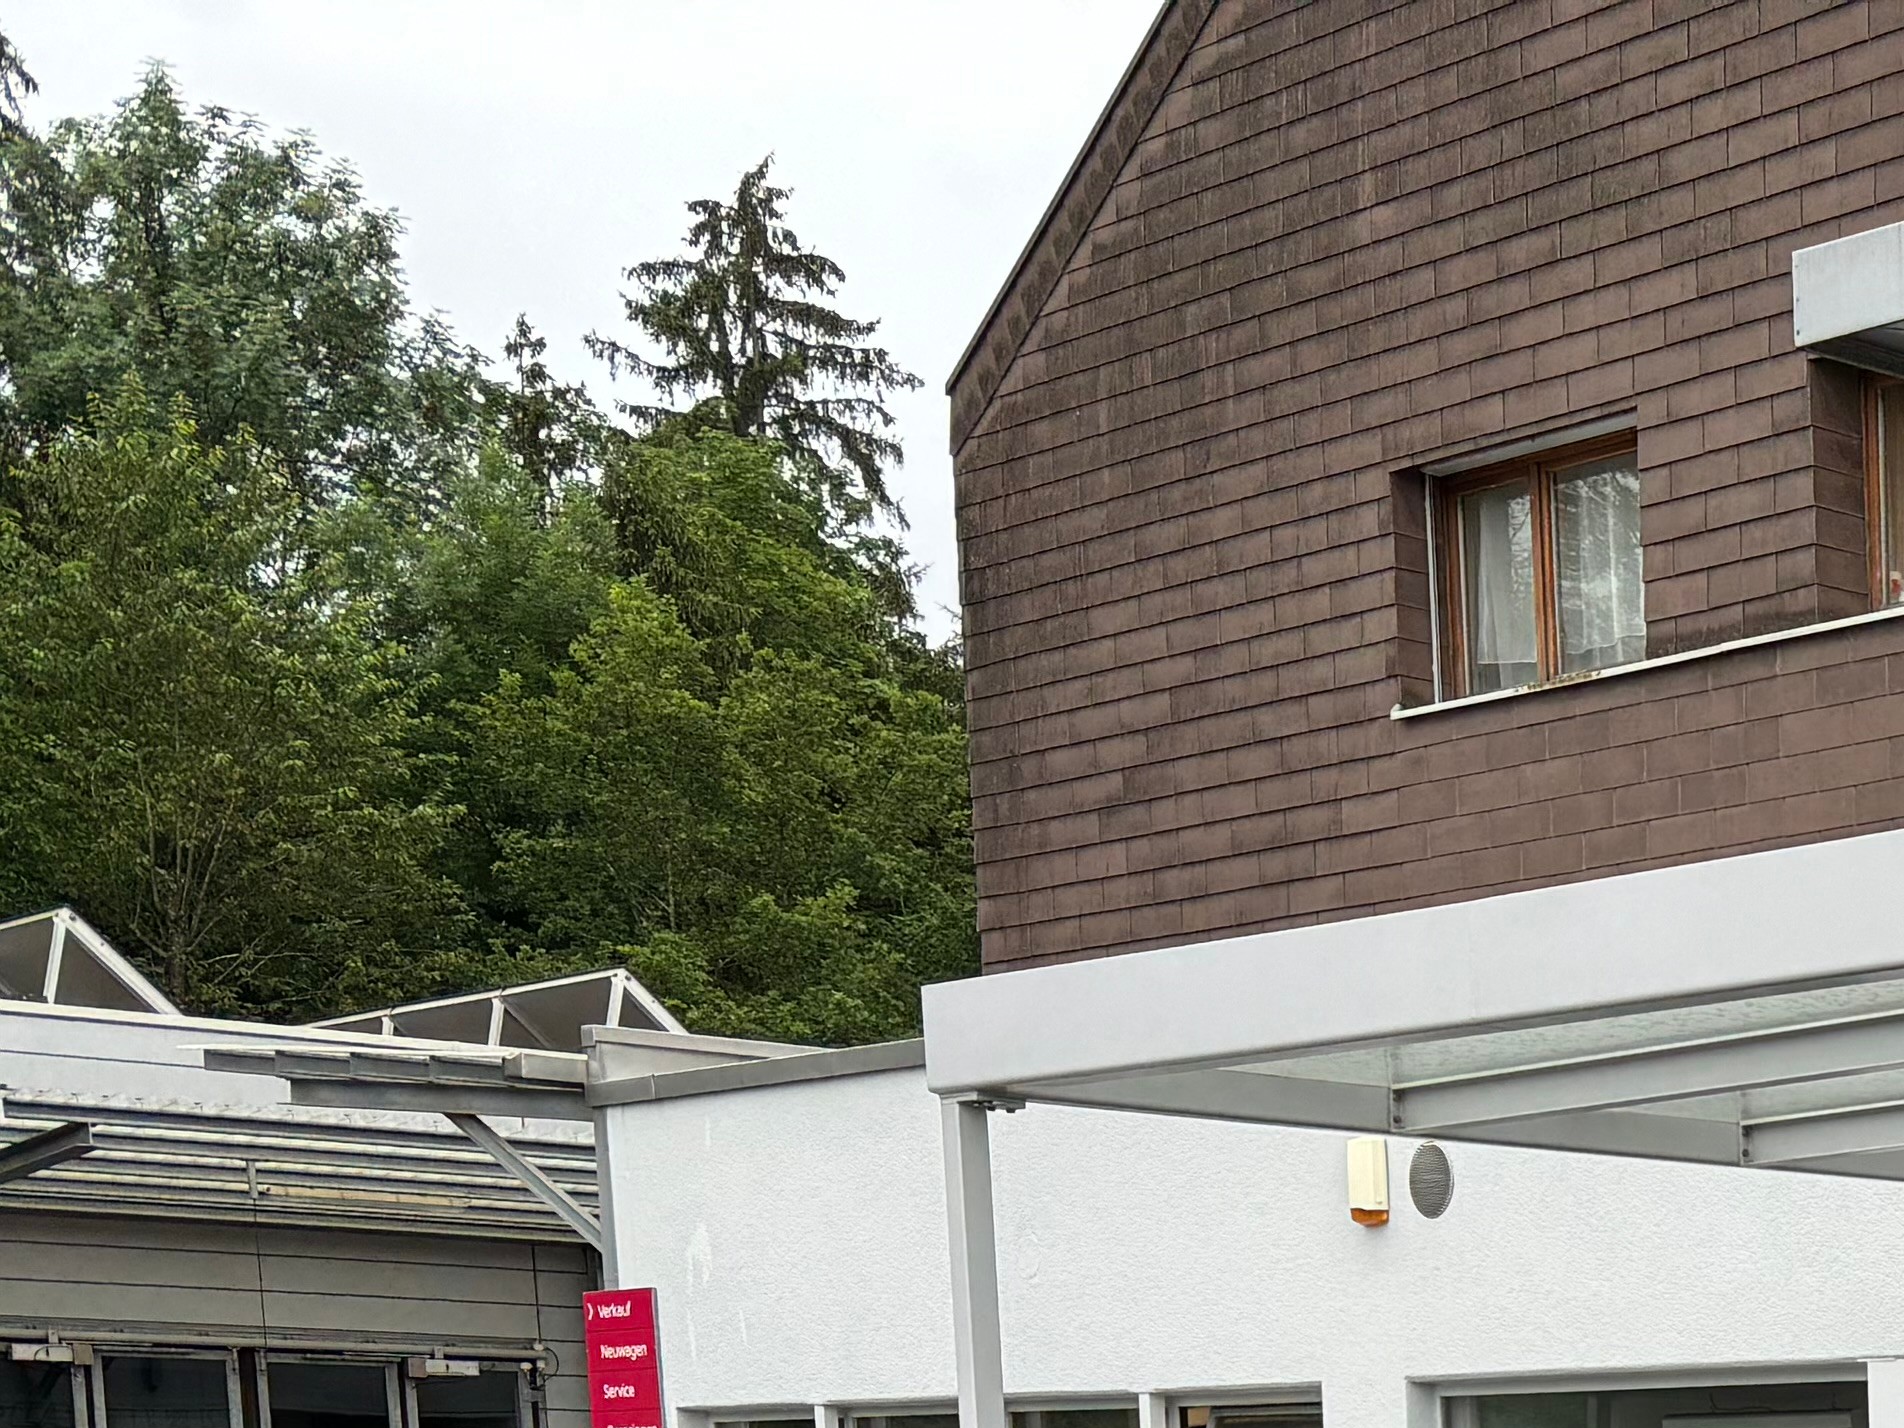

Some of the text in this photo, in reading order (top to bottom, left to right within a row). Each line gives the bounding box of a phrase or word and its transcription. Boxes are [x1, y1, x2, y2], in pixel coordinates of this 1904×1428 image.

[597, 1300, 631, 1319] Verkauf
[600, 1343, 648, 1362] Neuwagen
[603, 1382, 635, 1399] Service
